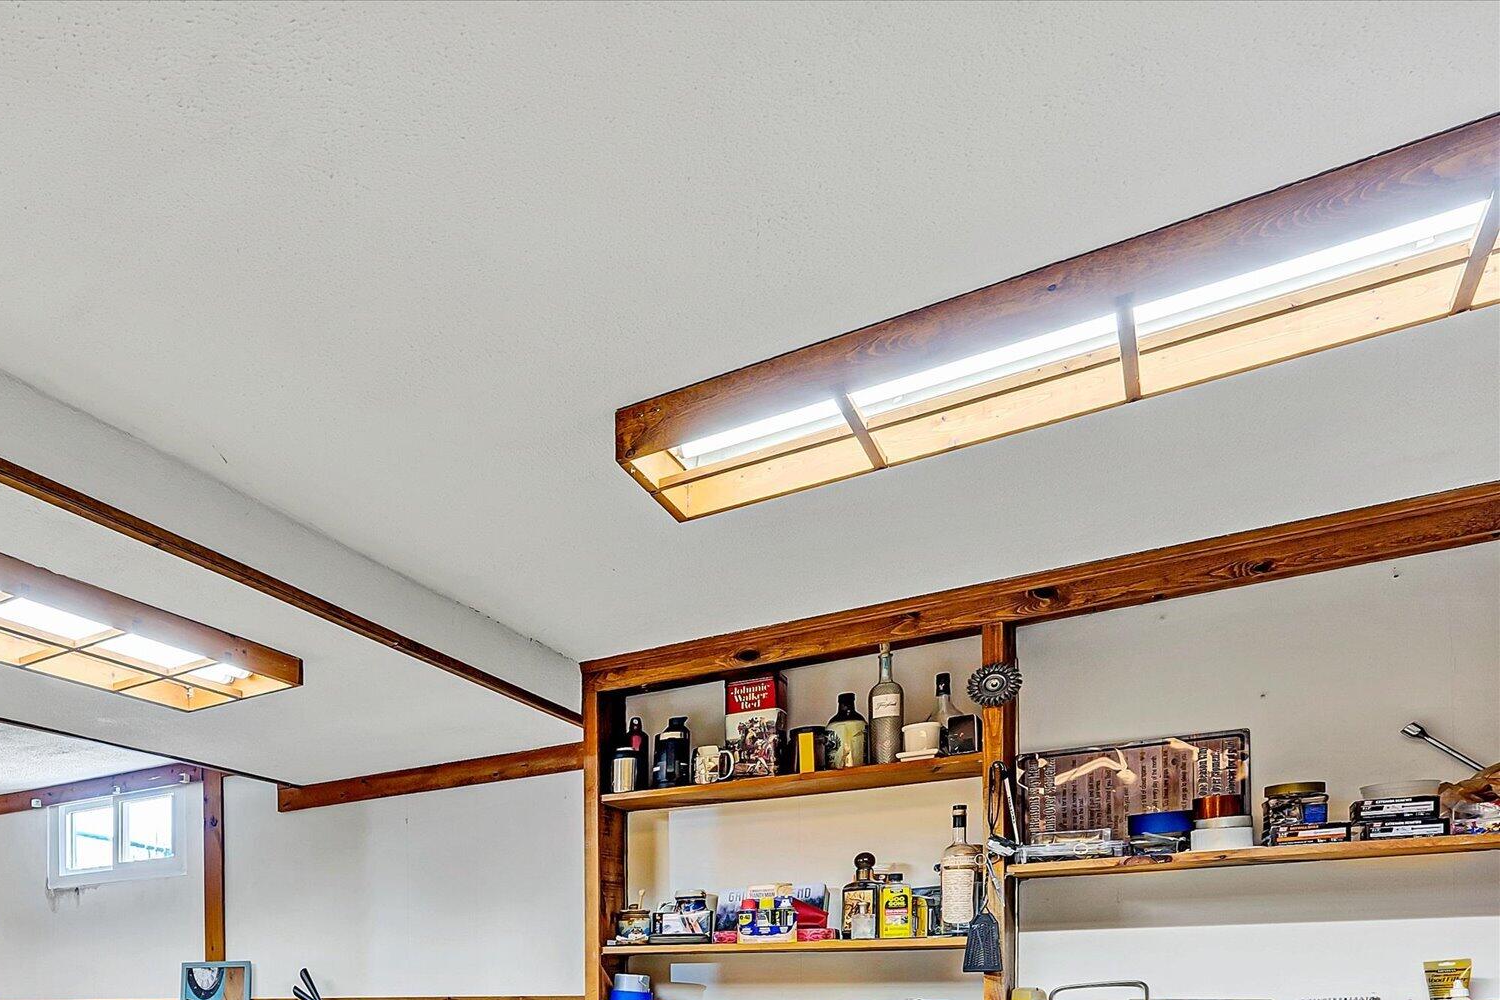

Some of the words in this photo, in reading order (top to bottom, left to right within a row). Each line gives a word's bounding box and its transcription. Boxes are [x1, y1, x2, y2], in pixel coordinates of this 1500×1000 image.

[730, 683, 770, 695] Johnnie
[734, 692, 769, 703] Walker
[741, 699, 761, 710] Red
